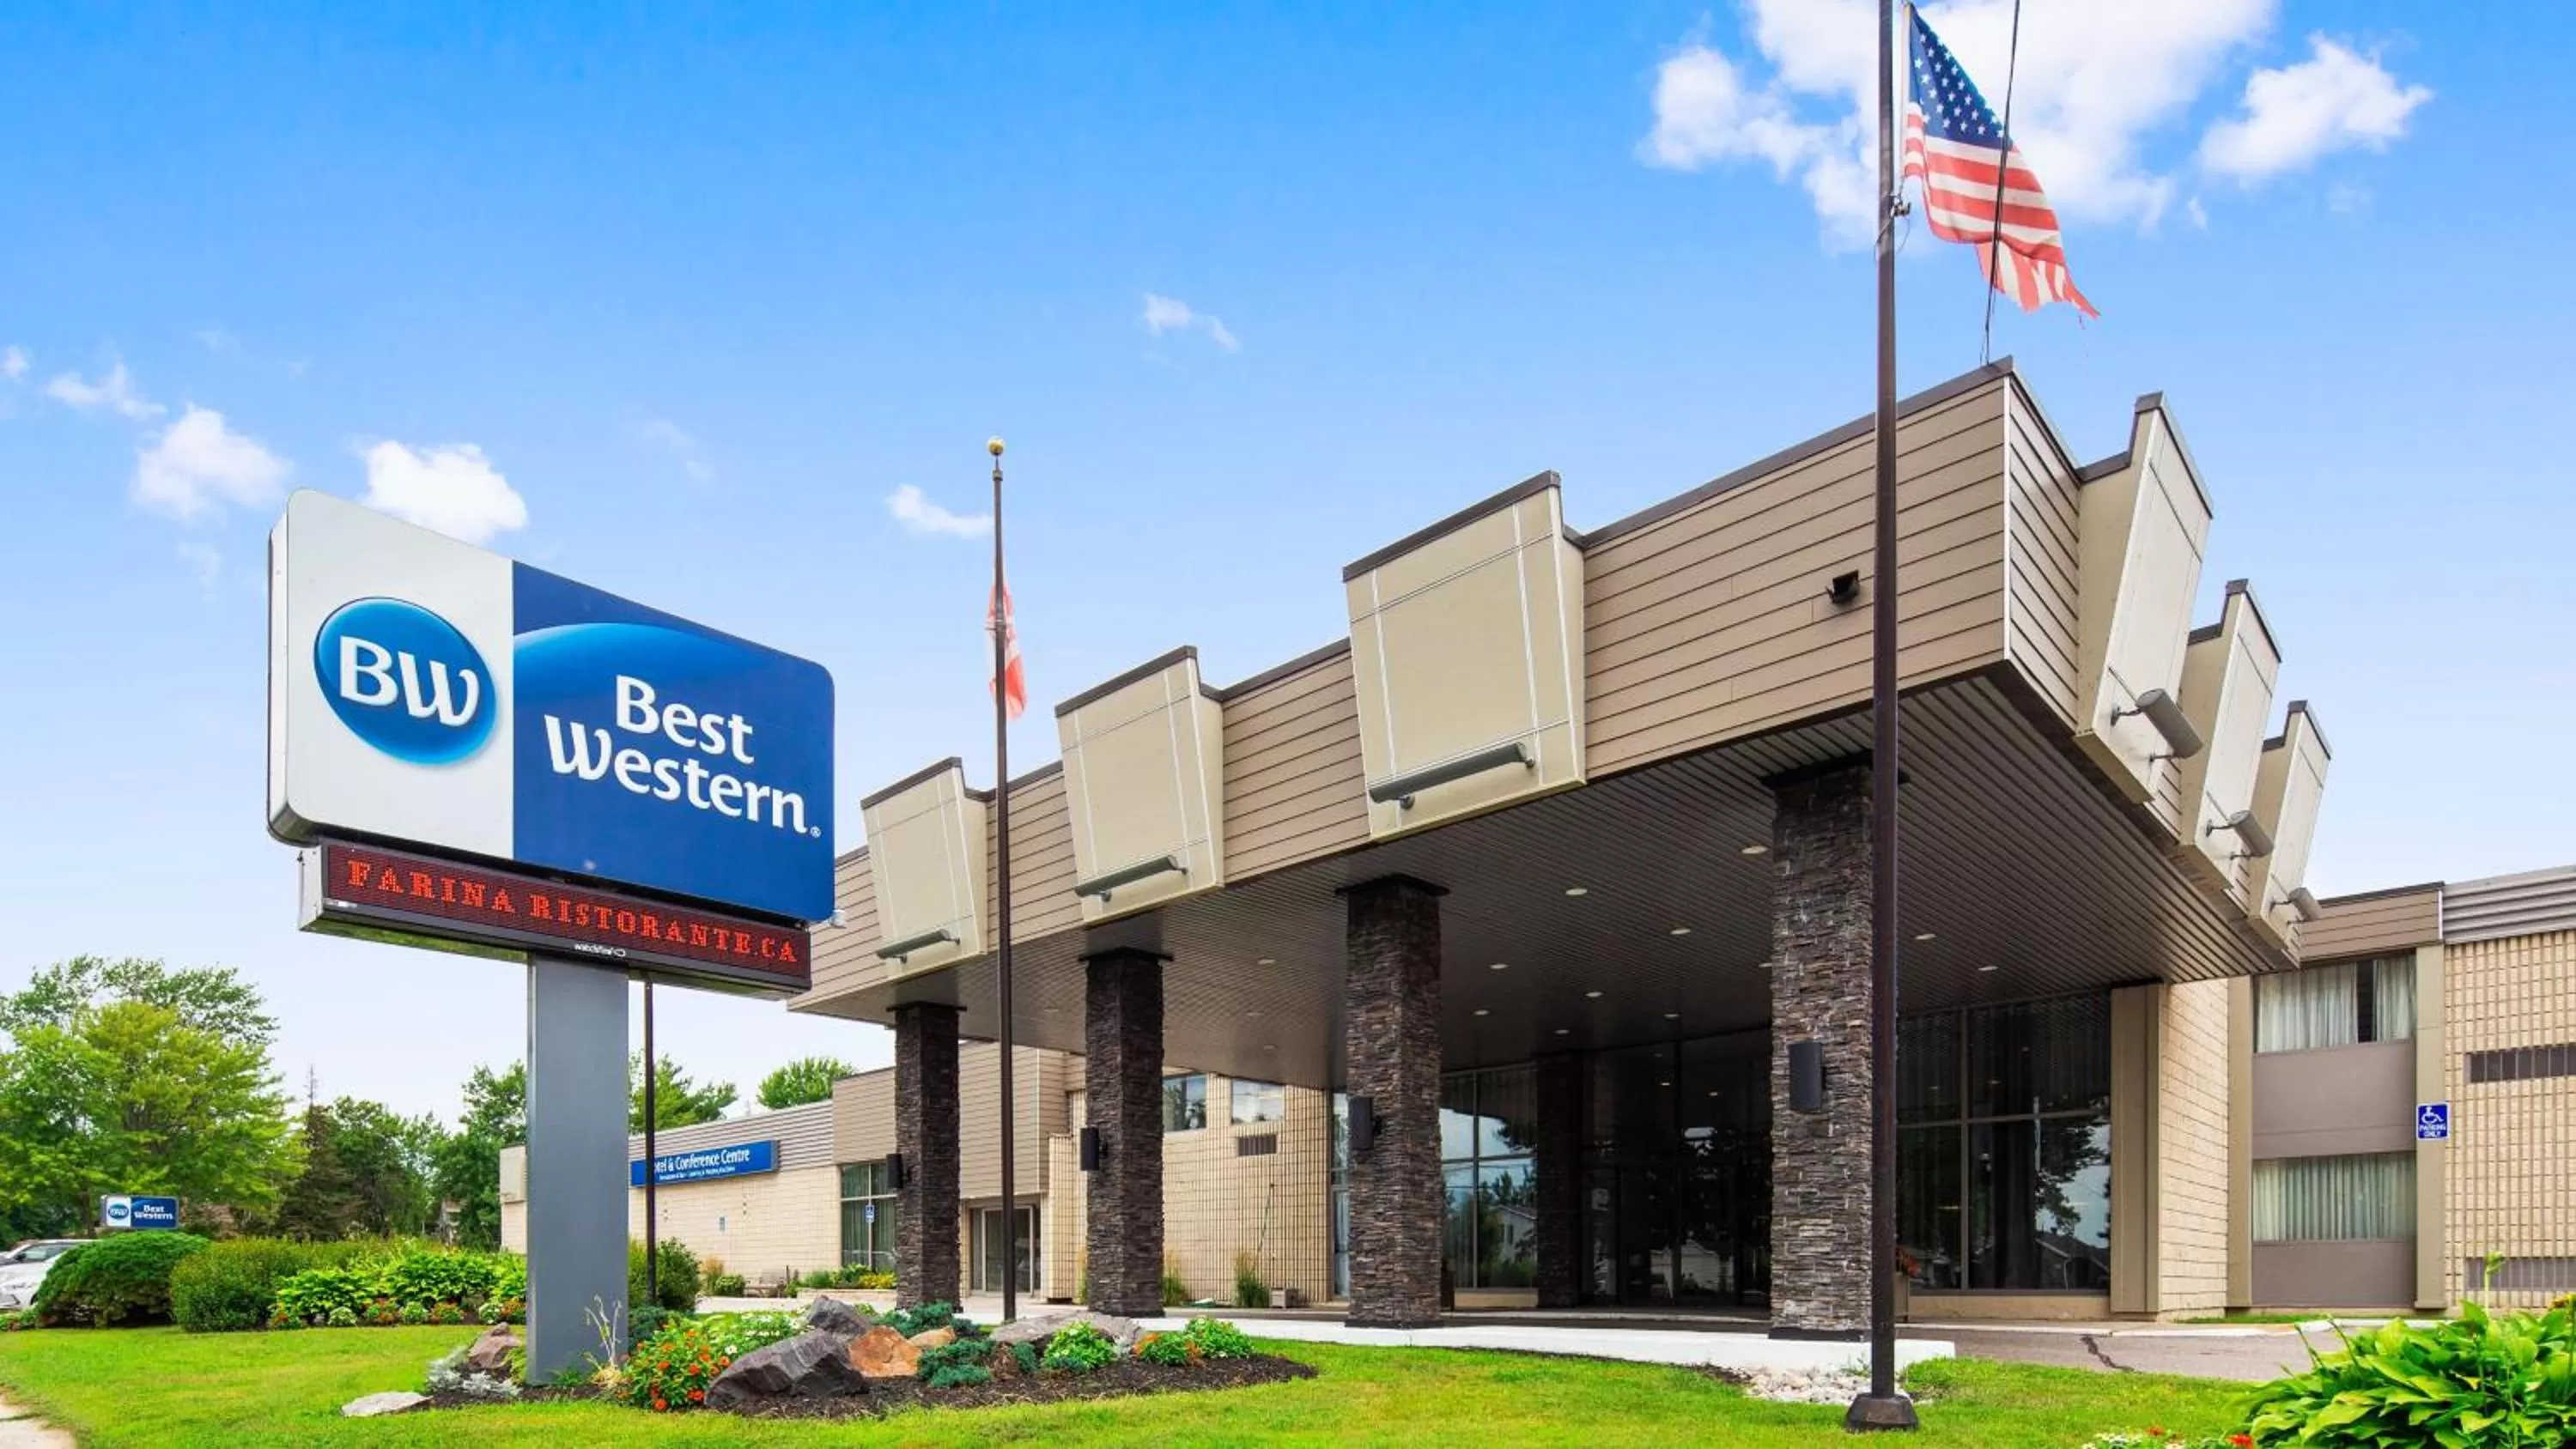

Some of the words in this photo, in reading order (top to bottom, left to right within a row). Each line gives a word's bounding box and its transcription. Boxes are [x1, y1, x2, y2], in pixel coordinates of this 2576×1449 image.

[339, 635, 480, 727] BW
[616, 674, 755, 765] Best
[544, 713, 809, 835] Western
[348, 859, 514, 914] FARINA
[529, 894, 799, 964] RISTORANTE.CA
[675, 1153, 720, 1171] Conference
[721, 1149, 750, 1164] Centre
[134, 1211, 173, 1220] Western
[143, 1204, 165, 1213] Best
